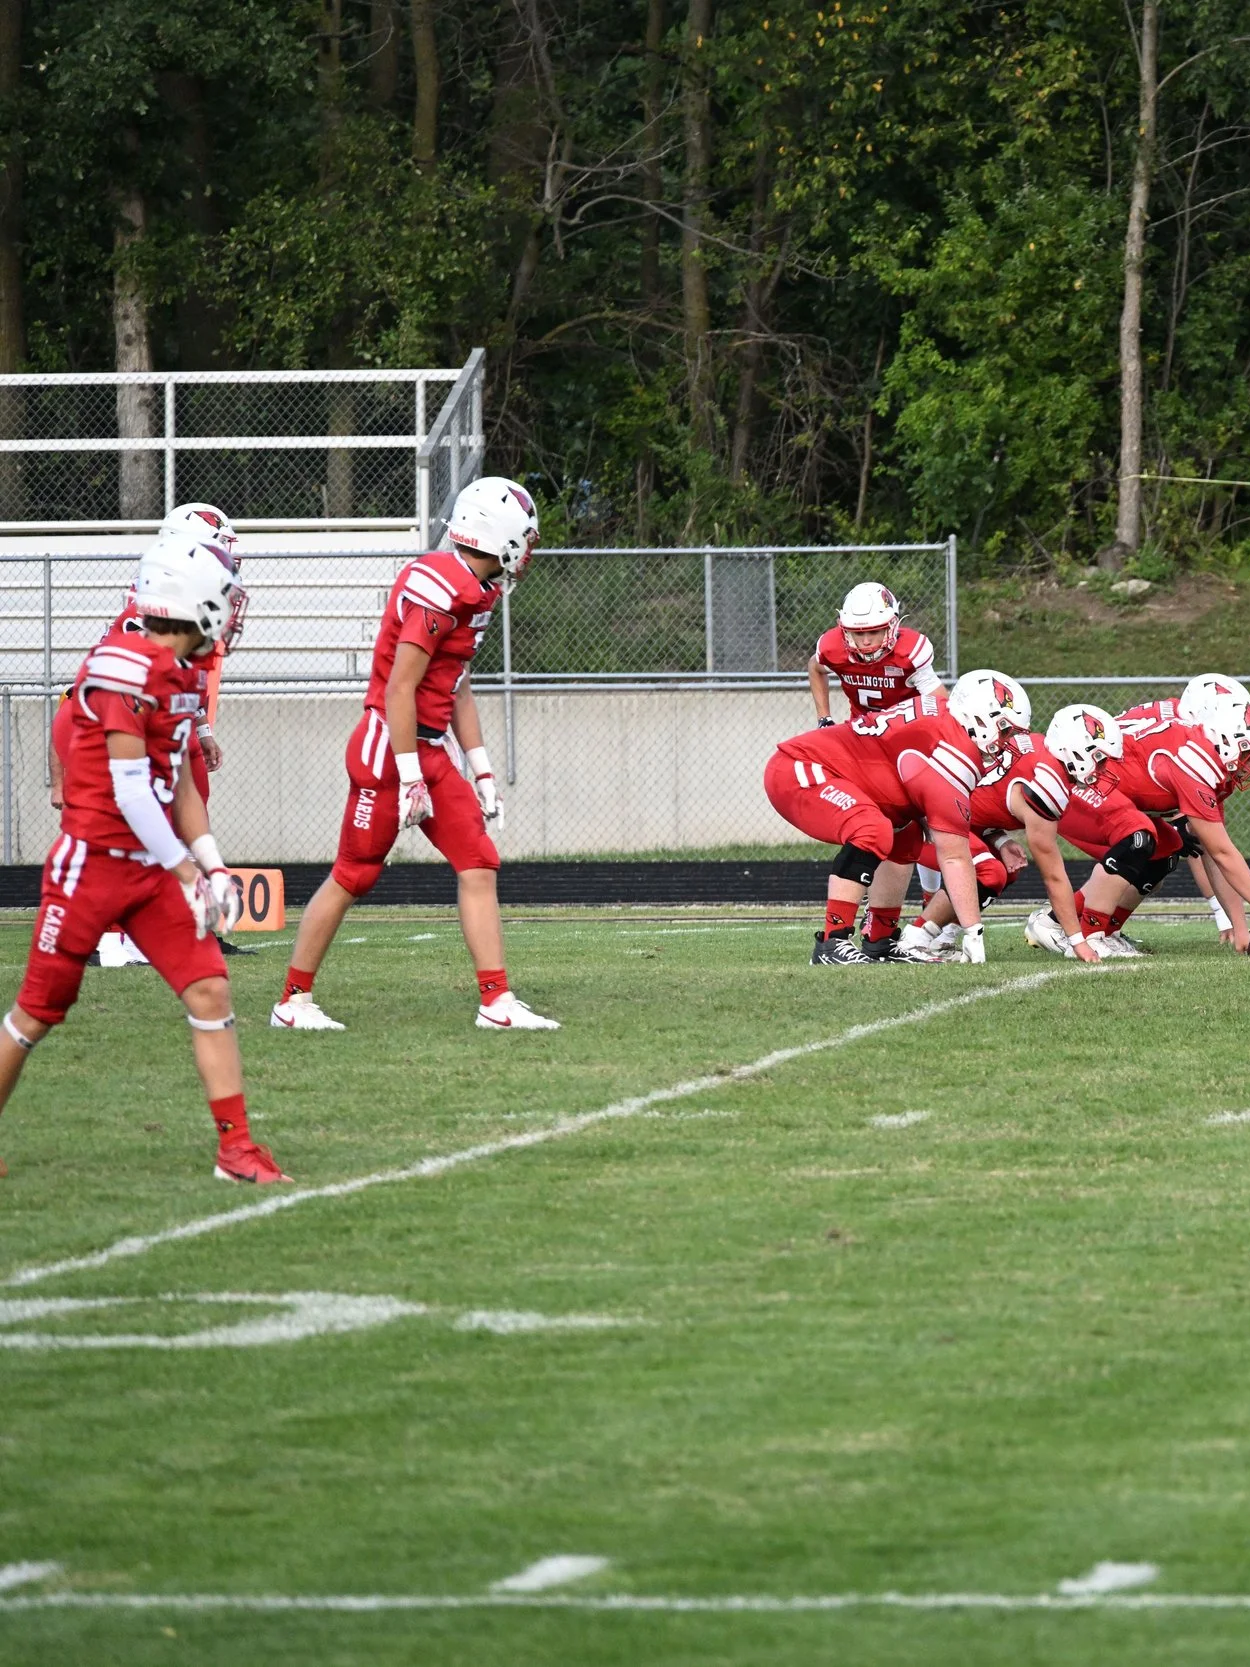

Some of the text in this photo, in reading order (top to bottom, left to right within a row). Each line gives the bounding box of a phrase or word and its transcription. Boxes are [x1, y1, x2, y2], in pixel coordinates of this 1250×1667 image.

[841, 673, 895, 689] MILLINGTON
[353, 788, 377, 830] CARDS
[819, 784, 857, 811] CARDS
[38, 904, 66, 955] CARDS
